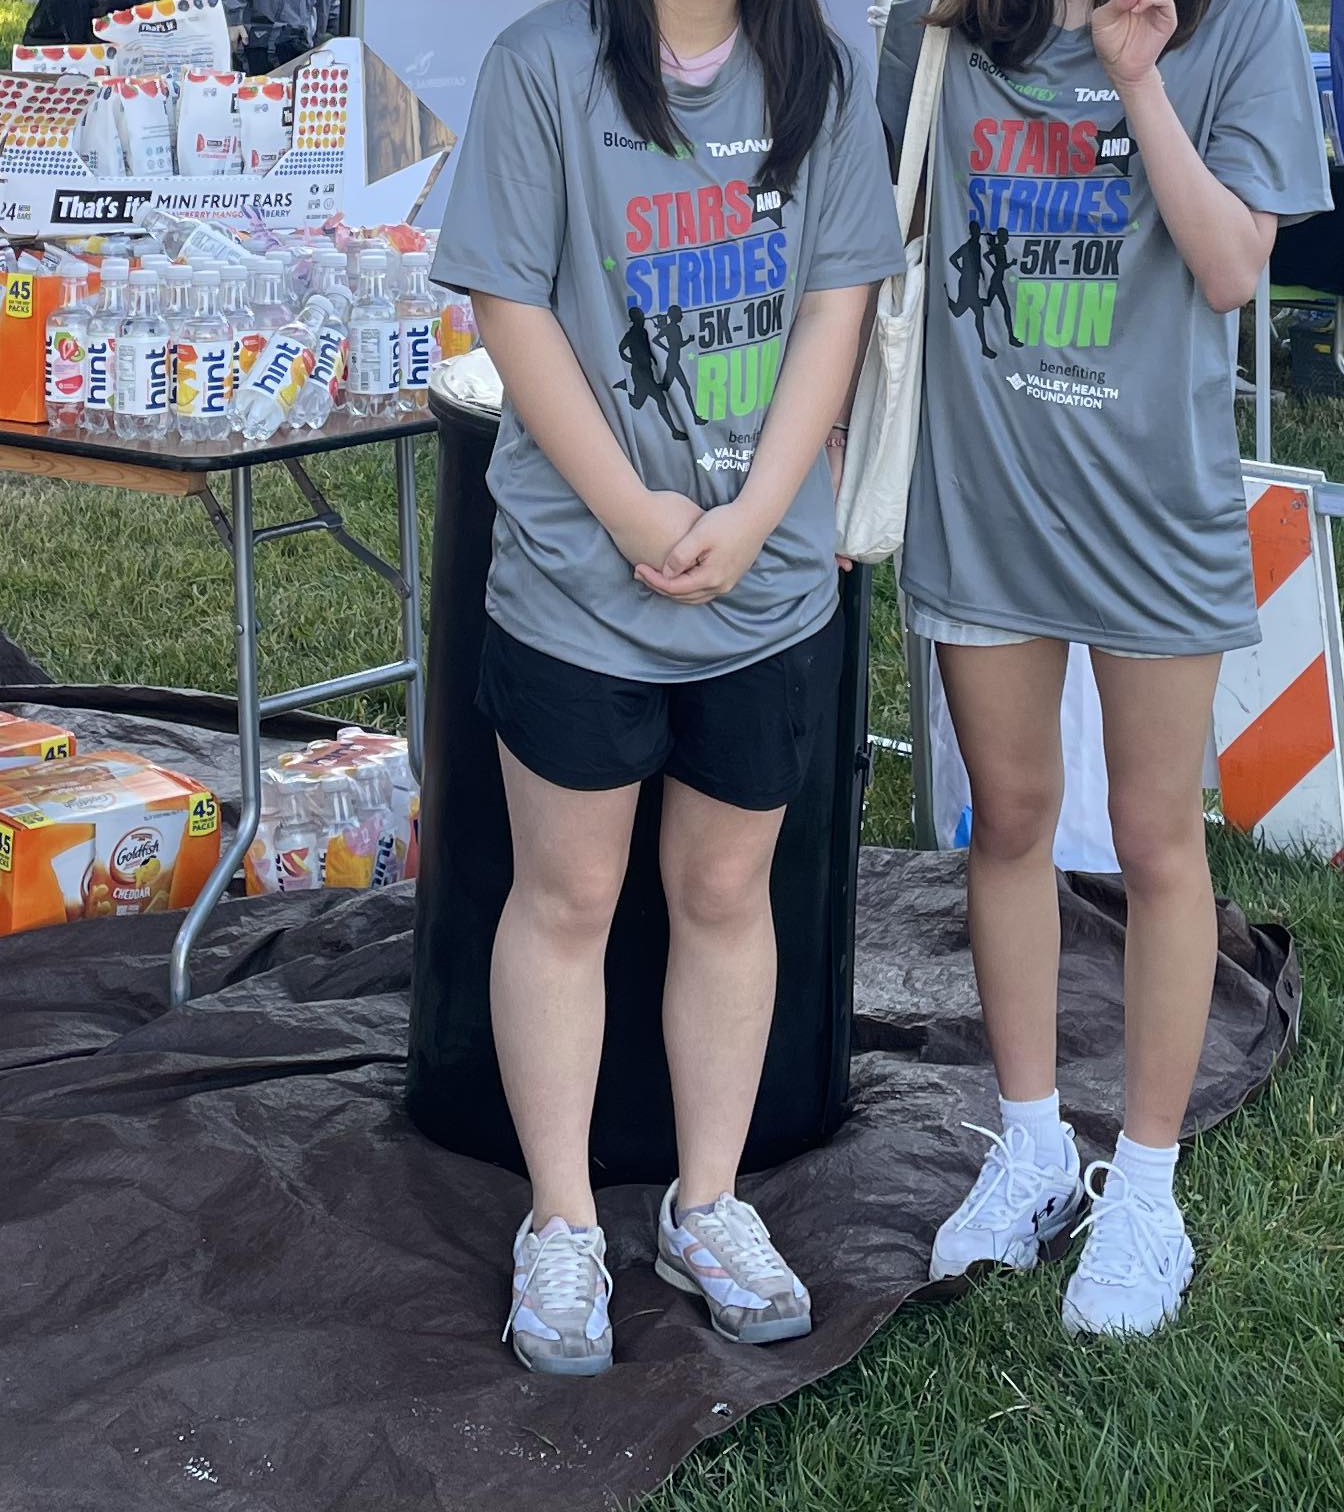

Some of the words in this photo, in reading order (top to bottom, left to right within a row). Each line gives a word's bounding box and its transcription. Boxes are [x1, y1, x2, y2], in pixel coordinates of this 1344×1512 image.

[969, 116, 1098, 175] STARS
[1101, 137, 1130, 157] AND
[58, 195, 119, 219] That's
[157, 194, 197, 208] MINI
[201, 193, 249, 208] FRUIT
[253, 193, 293, 208] BARS
[625, 180, 753, 254] STARS
[755, 190, 781, 213] AND
[969, 177, 1132, 234] STRIDES
[625, 231, 787, 315] STRIDES
[1019, 239, 1124, 276] 5K-10K
[8, 304, 30, 314] PACKS
[9, 280, 31, 300] 45
[698, 298, 785, 348] 5K-10K
[1013, 281, 1117, 348] RUN
[87, 342, 107, 405] hint
[252, 342, 301, 395] hint
[309, 331, 341, 385] hint
[406, 325, 430, 385] hint
[1039, 359, 1106, 383] benefiting
[145, 345, 167, 410] hint
[201, 349, 226, 413] hint
[1026, 373, 1069, 393] VALLEY
[1071, 381, 1119, 400] HEALTH
[1026, 387, 1103, 410] FOUNDATION
[714, 447, 754, 461] VALLE
[192, 799, 216, 818] 45
[192, 822, 216, 831] PACKS
[116, 841, 160, 865] Goldfish
[112, 887, 151, 900] CHEDDAR
